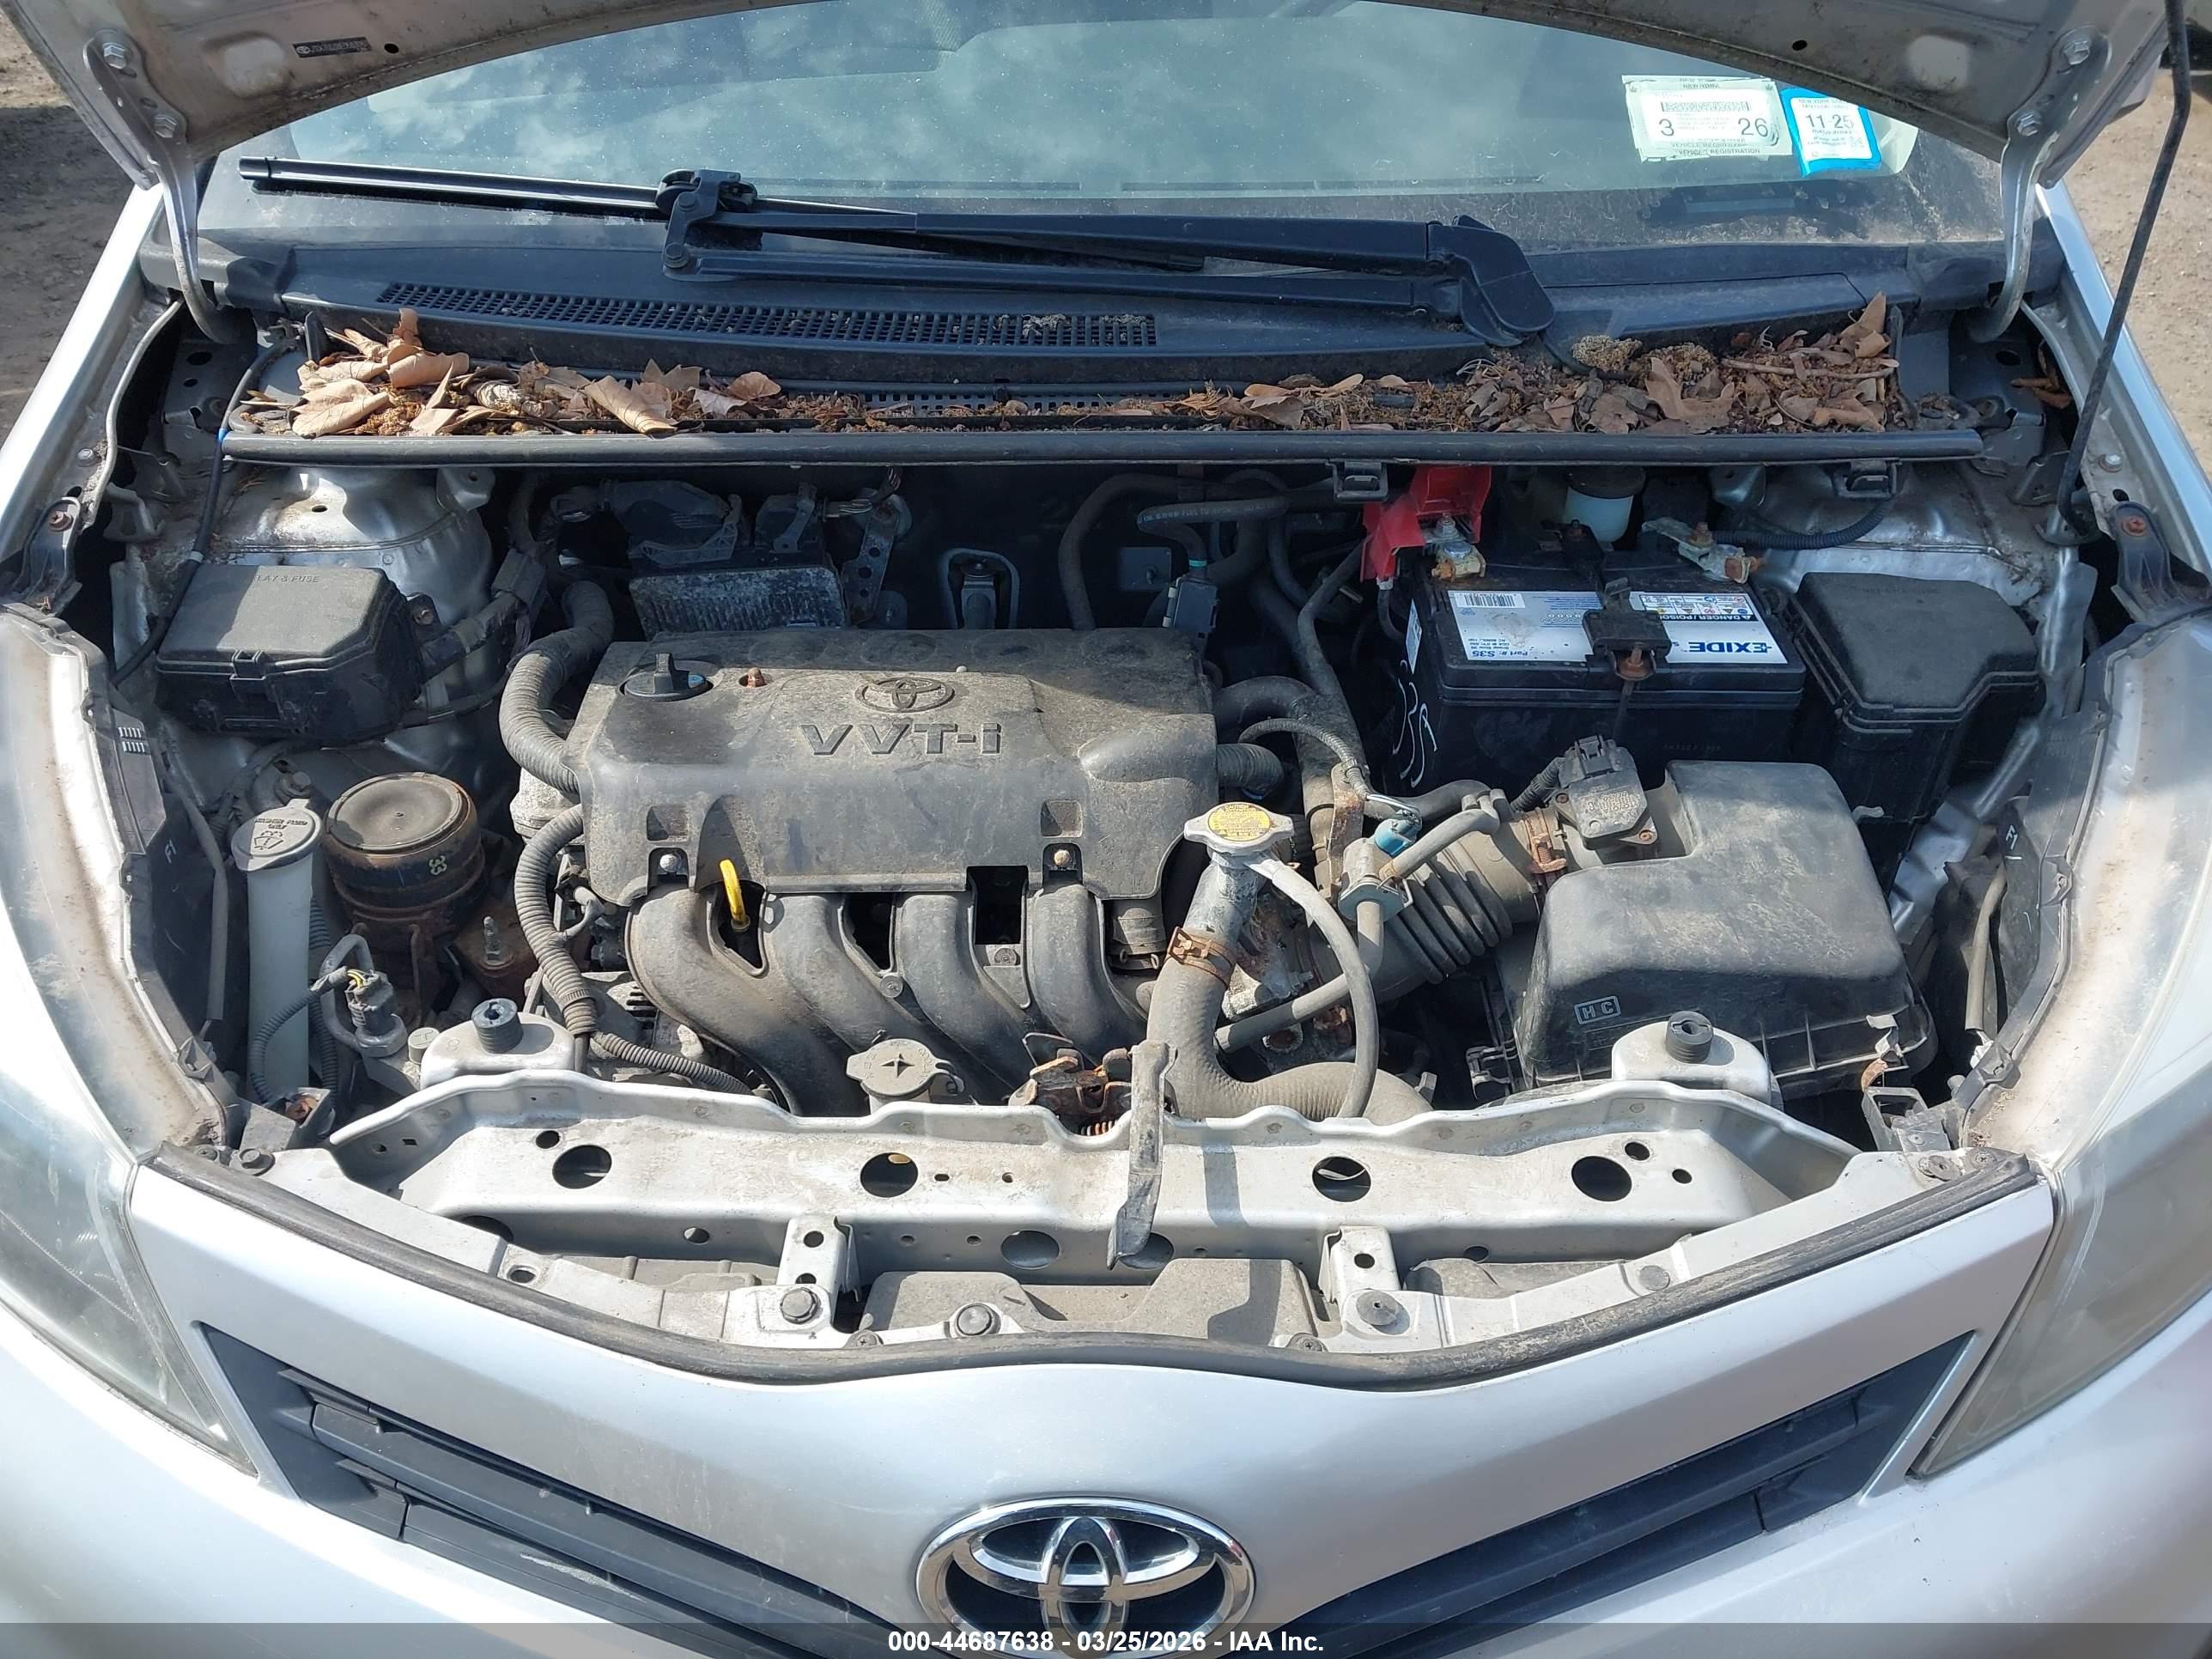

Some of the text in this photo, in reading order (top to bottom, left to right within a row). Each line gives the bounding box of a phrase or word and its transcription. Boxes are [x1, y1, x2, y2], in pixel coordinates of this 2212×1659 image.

[1658, 118, 1674, 137] 3
[1737, 118, 1769, 137] 26
[291, 574, 320, 583] FUSE
[1685, 641, 1772, 653] EXIDE
[800, 722, 1003, 756] VVT-i
